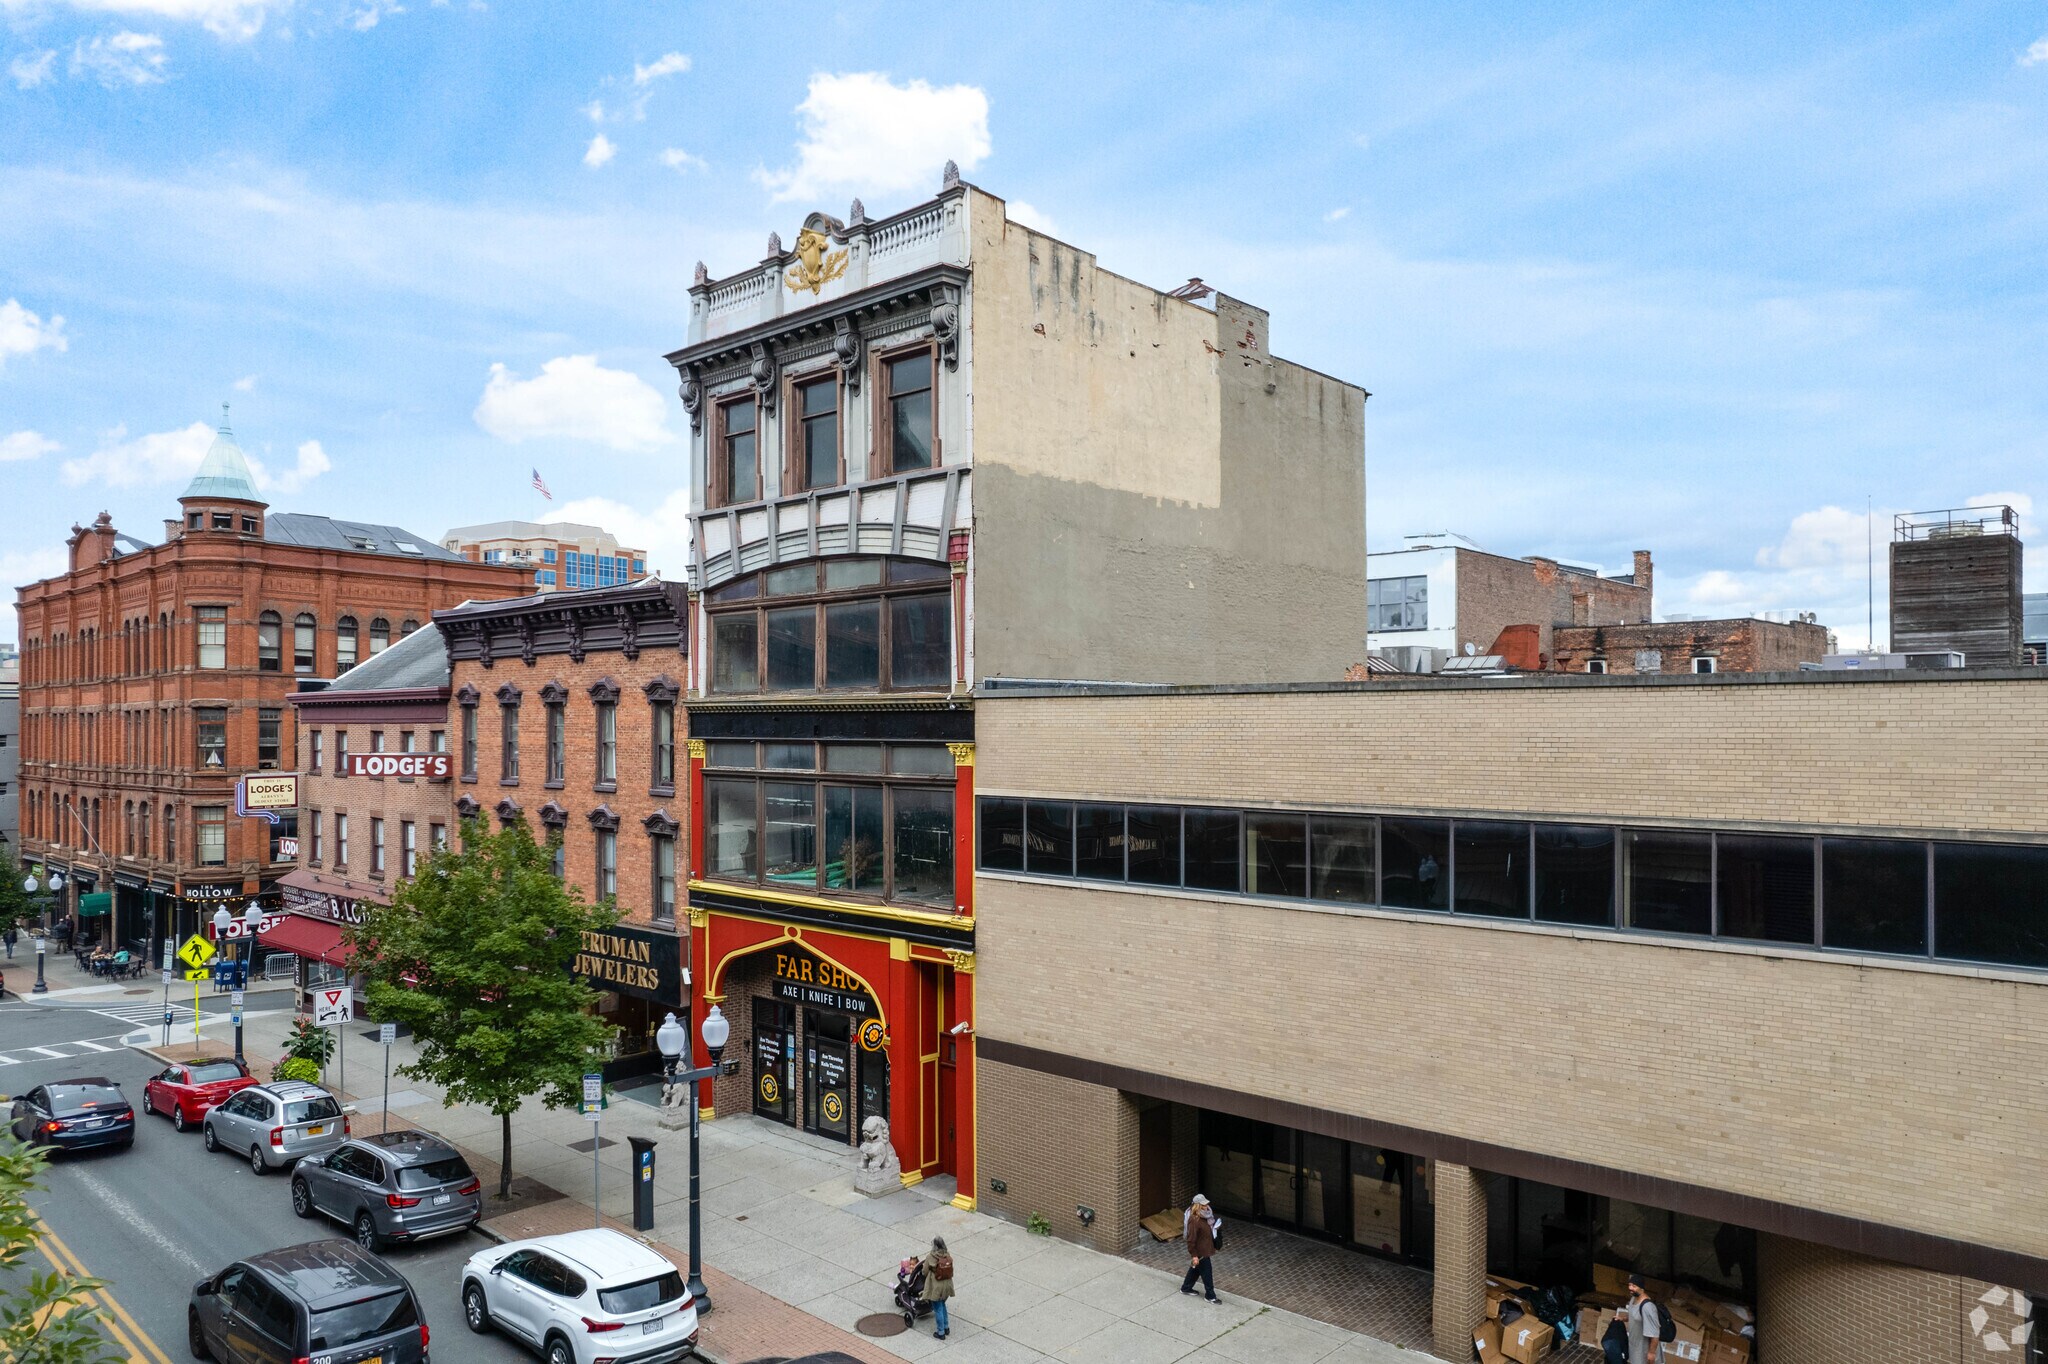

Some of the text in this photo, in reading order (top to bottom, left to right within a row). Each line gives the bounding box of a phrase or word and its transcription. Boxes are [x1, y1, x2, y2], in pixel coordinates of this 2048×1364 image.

[446, 540, 459, 551] 677
[355, 757, 448, 775] LODGE'S
[250, 784, 293, 794] LODGE'S
[186, 888, 233, 897] HOLLOW
[580, 930, 651, 963] TRUMAN
[572, 953, 659, 990] JEWELERS
[776, 954, 870, 994] FAR SHO
[782, 985, 866, 1012] AXE KNIFE BOW
[319, 1005, 331, 1013] HERE
[643, 1152, 649, 1162] P
